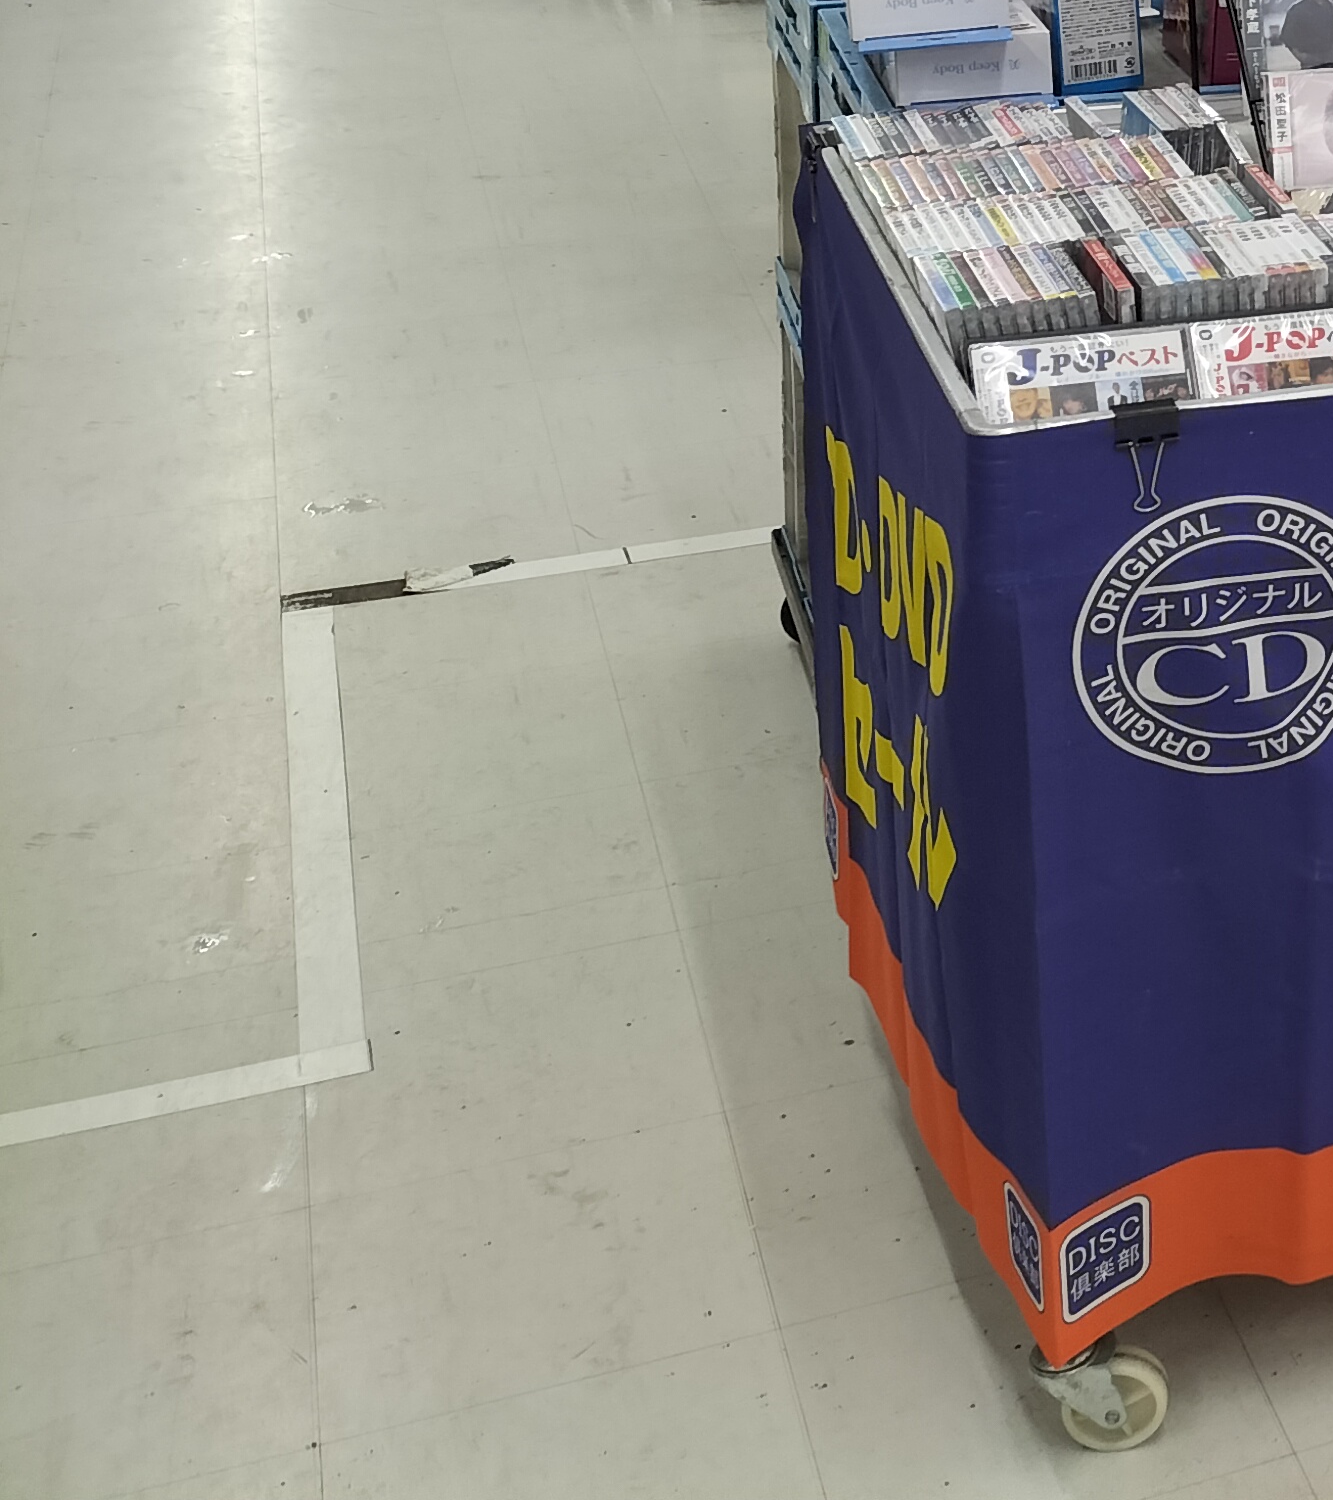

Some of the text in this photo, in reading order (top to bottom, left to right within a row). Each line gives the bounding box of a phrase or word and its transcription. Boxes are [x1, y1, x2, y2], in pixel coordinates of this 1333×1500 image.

[1274, 91, 1290, 143] 松田聖子
[1089, 512, 1221, 635] ORIGINAL
[1141, 580, 1323, 629] オリジナル
[1135, 630, 1326, 706] CD
[1089, 663, 1212, 762] ORIGINAL
[1067, 1215, 1141, 1276] DISC
[1069, 1242, 1141, 1303] 倶楽部
